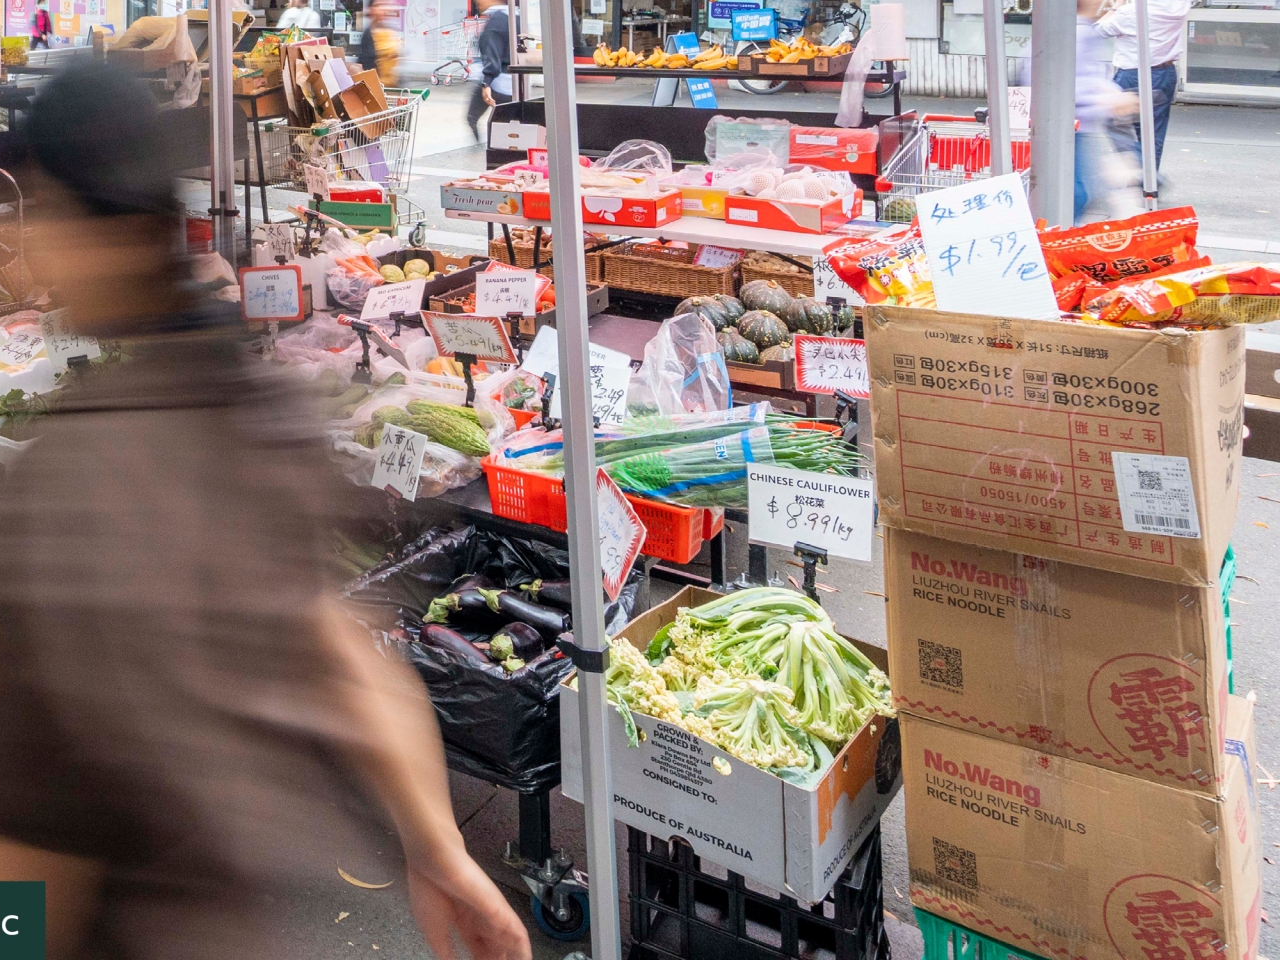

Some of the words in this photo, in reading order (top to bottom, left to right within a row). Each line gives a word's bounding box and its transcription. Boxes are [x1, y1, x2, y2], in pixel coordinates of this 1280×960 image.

[452, 193, 474, 204] Fresh
[930, 189, 1014, 225] 处理价
[444, 320, 481, 337] 苦瓜
[1052, 373, 1159, 398] 300gx30包
[1053, 390, 1161, 417] 268gx30包
[1074, 420, 1157, 443] 生产日期
[750, 472, 794, 487] CHINESE
[797, 479, 870, 499] CAULIFLOWER
[988, 461, 1065, 485] 柳州螺蛳粉
[795, 494, 825, 509] 松花菜
[979, 486, 1067, 510] 4500/15050
[921, 499, 1068, 538] 广西全汇食品有限公司
[1085, 528, 1165, 555] 制造生产
[911, 551, 1027, 598] No.Wang
[912, 575, 970, 597] LIUZHOU
[974, 589, 1016, 607] RIVER
[1020, 599, 1071, 620] SNAILS
[913, 588, 944, 604] RICE
[948, 596, 1006, 619] NOODLE
[653, 730, 688, 750] PACKED
[690, 744, 704, 756] BY:
[656, 723, 691, 742] GROWN
[693, 736, 700, 746] &
[642, 768, 700, 797] CONSIGNED
[701, 792, 718, 805] TO:
[923, 748, 1041, 808] No.Wang
[925, 773, 984, 801] LIUZHOU
[987, 795, 1030, 817] RIVER
[1034, 809, 1087, 835] SNAILS
[926, 786, 958, 806] RICE
[961, 798, 1020, 827] NOODLE
[613, 793, 666, 824] PRODUCE
[668, 818, 685, 831] OF
[686, 826, 754, 862] AUSTRALIA
[823, 845, 847, 882] PRODUCE
